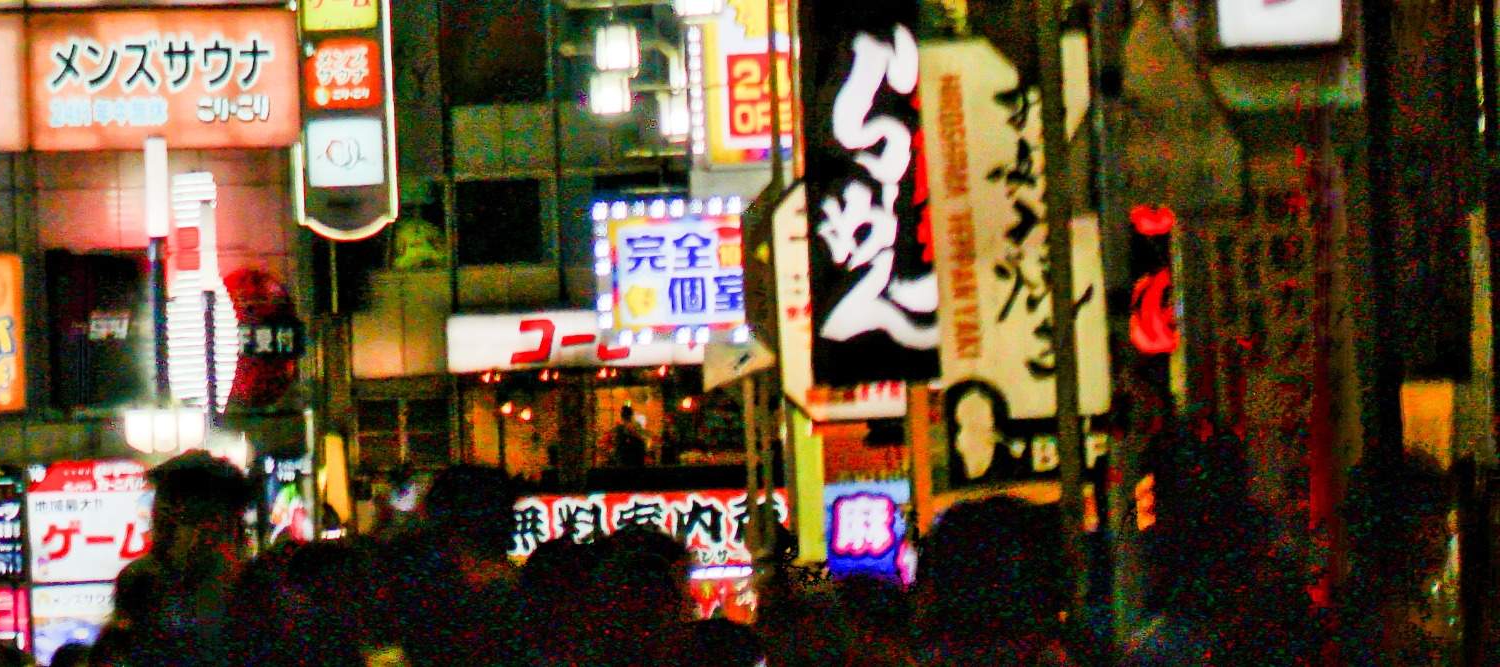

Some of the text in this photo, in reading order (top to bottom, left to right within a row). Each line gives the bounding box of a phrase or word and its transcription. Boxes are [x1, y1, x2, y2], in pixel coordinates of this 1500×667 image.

[50, 37, 271, 90] メンズサウナ
[625, 232, 713, 273] 完全
[668, 274, 746, 315] 個室
[42, 519, 154, 561] ゲーム
